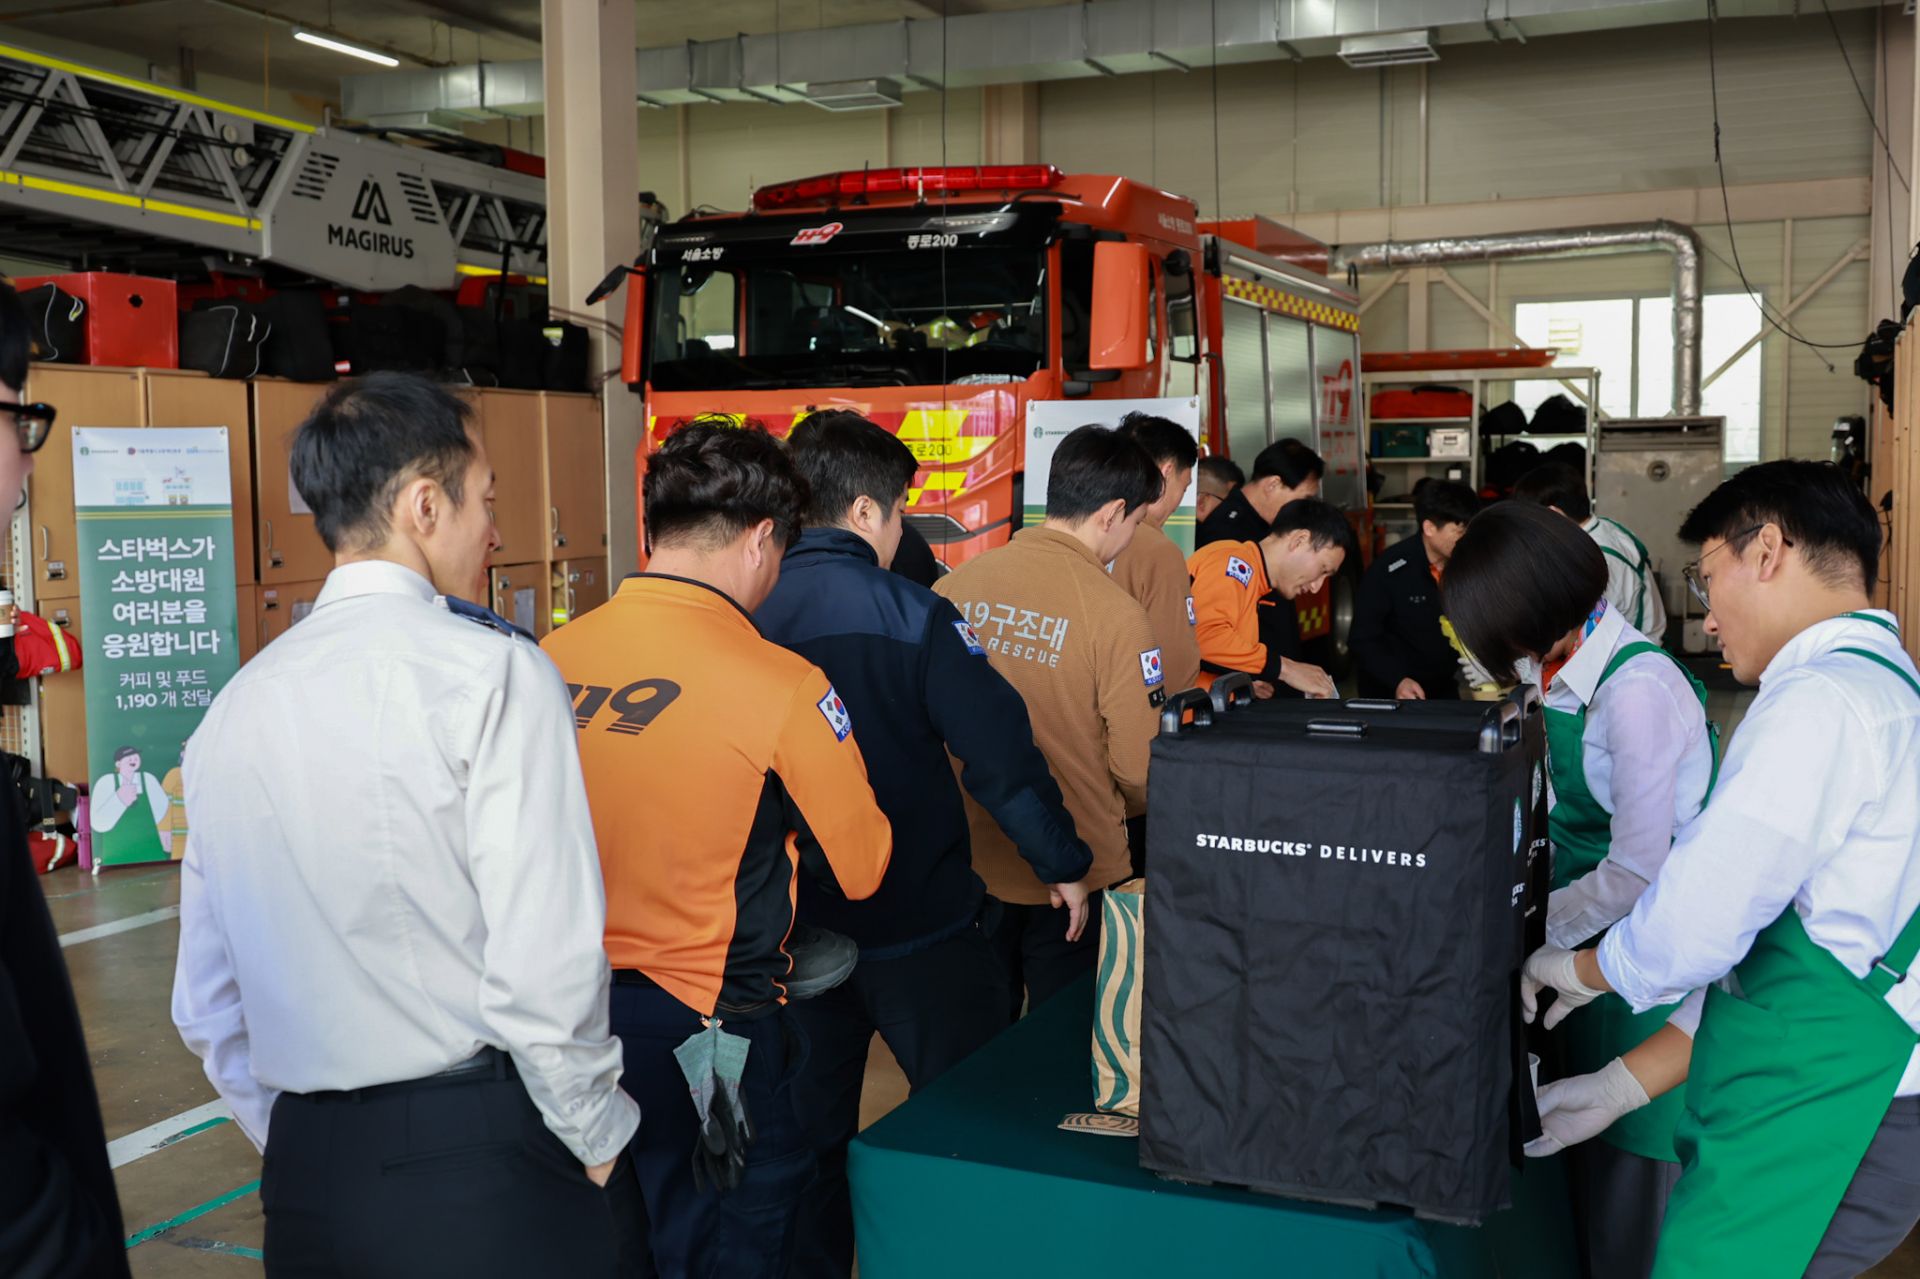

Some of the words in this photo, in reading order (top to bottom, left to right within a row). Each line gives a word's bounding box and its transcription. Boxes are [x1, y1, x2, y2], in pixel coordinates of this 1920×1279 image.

[328, 223, 414, 259] MAGIRUS
[681, 247, 724, 262] 서울소방
[98, 536, 216, 562] 스타벅스가
[111, 567, 205, 594] 소방대원
[113, 598, 207, 626] 여러분을
[953, 601, 1069, 652] 19구조대
[102, 629, 220, 659] 응원합니다
[987, 637, 1060, 668] RESCUE
[120, 672, 151, 689] 커피
[155, 671, 171, 688] 및
[175, 669, 208, 687] 푸드
[115, 693, 157, 711] 1,190
[161, 690, 177, 707] 개
[181, 688, 213, 707] 전달
[1320, 845, 1426, 867] DELIVERS
